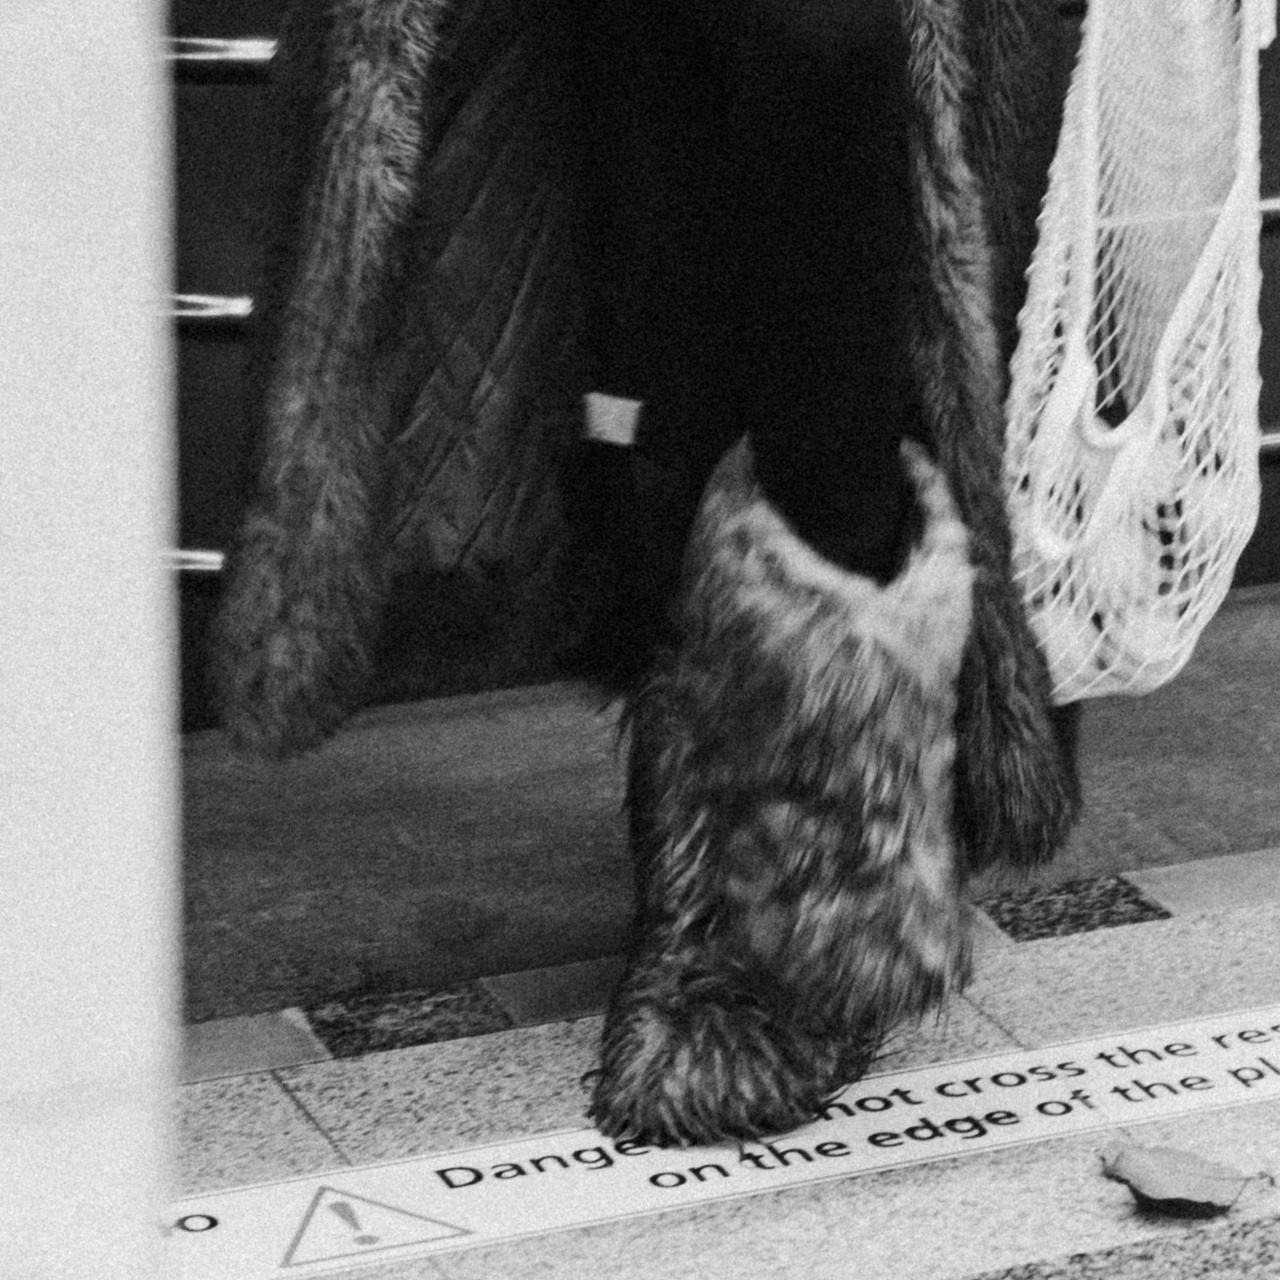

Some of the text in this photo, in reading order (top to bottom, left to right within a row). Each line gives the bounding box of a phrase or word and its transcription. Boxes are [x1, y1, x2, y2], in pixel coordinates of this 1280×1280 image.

[434, 1137, 651, 1189] Dange
[815, 1087, 925, 1121] not
[935, 1060, 1087, 1098] cross
[1095, 1043, 1199, 1070] the
[648, 1162, 732, 1189] on
[741, 1139, 853, 1170] the
[866, 1108, 1020, 1149] edge
[1035, 1088, 1097, 1117] of
[1110, 1074, 1215, 1104] the
